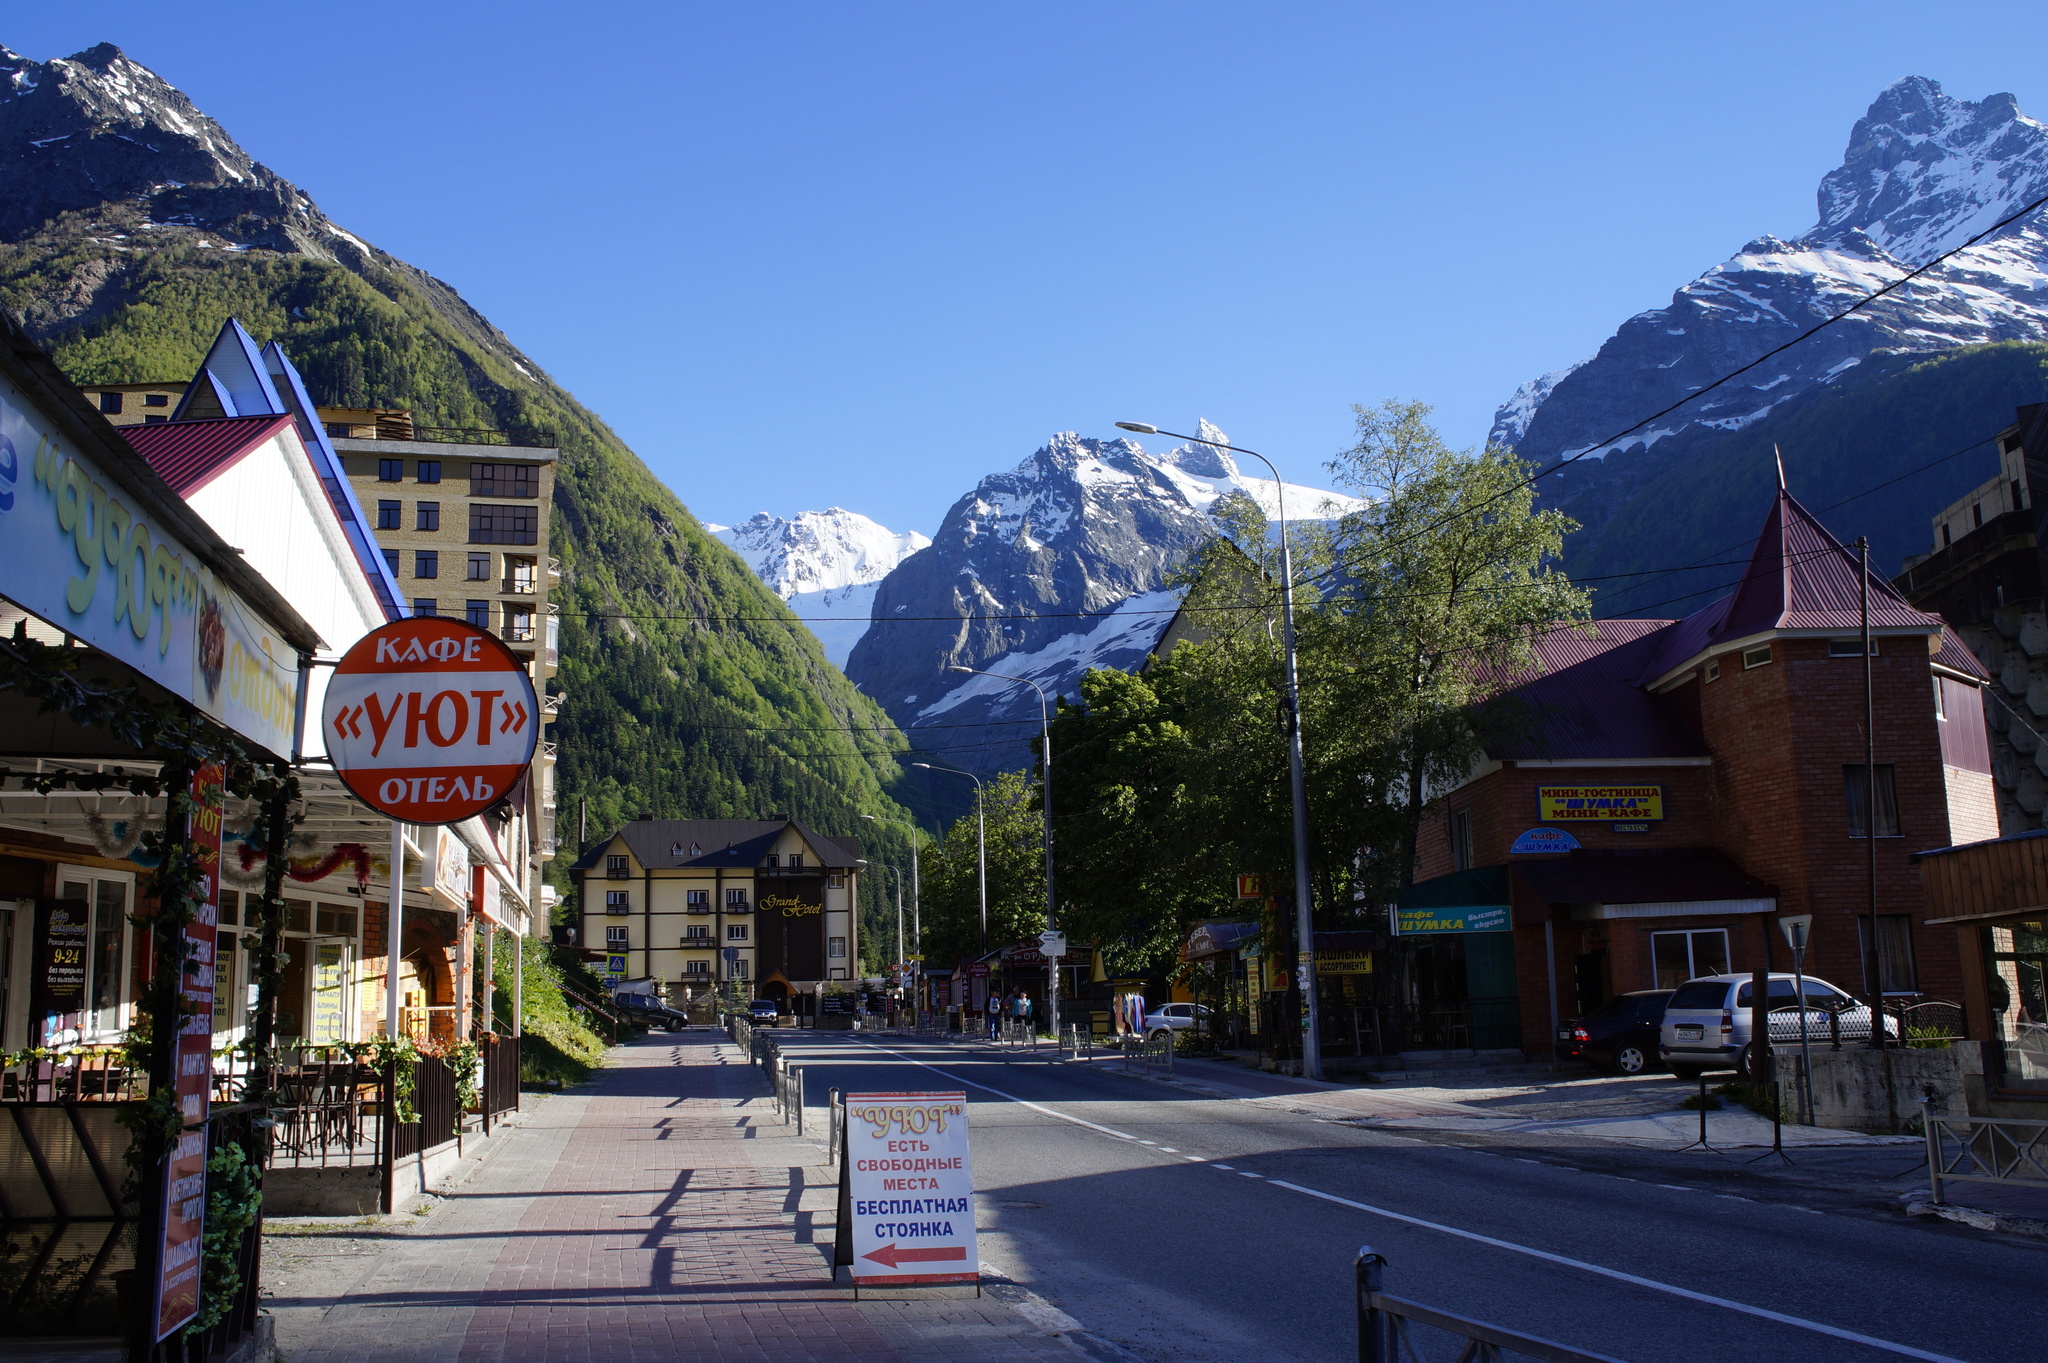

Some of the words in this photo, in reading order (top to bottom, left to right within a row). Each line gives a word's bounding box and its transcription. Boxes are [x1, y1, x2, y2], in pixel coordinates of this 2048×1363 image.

[375, 636, 483, 664] КАФЕ
[229, 635, 296, 739] отдых
[333, 689, 528, 759] «УЮТ»
[379, 775, 494, 805] ОТЕЛЬ
[1541, 788, 1660, 799] МИНИ-ГОСТИНИЦА
[1616, 824, 1634, 832] МЕСТА
[1634, 824, 1648, 832] ЕСТЬ
[1530, 831, 1563, 842] кафе
[782, 903, 822, 917] Hotel
[1397, 911, 1435, 920] кафе
[1398, 919, 1465, 931] ШУМКА
[1474, 918, 1505, 929] вкусно
[54, 949, 80, 964] 9-24
[1320, 961, 1367, 972] АССОРТИМЕНТЕ
[182, 1053, 206, 1076] МАНТЫ
[182, 1094, 200, 1117] ПЛОВ
[888, 1140, 930, 1153] ЕСТЬ
[857, 1157, 963, 1173] СВОБОДНЫЕ
[883, 1177, 939, 1191] МЕСТА
[856, 1197, 968, 1216] БЕСПЛАТНАЯ
[875, 1221, 953, 1238] СТОЯНКА
[165, 1236, 199, 1273] ШАШЛЫК
